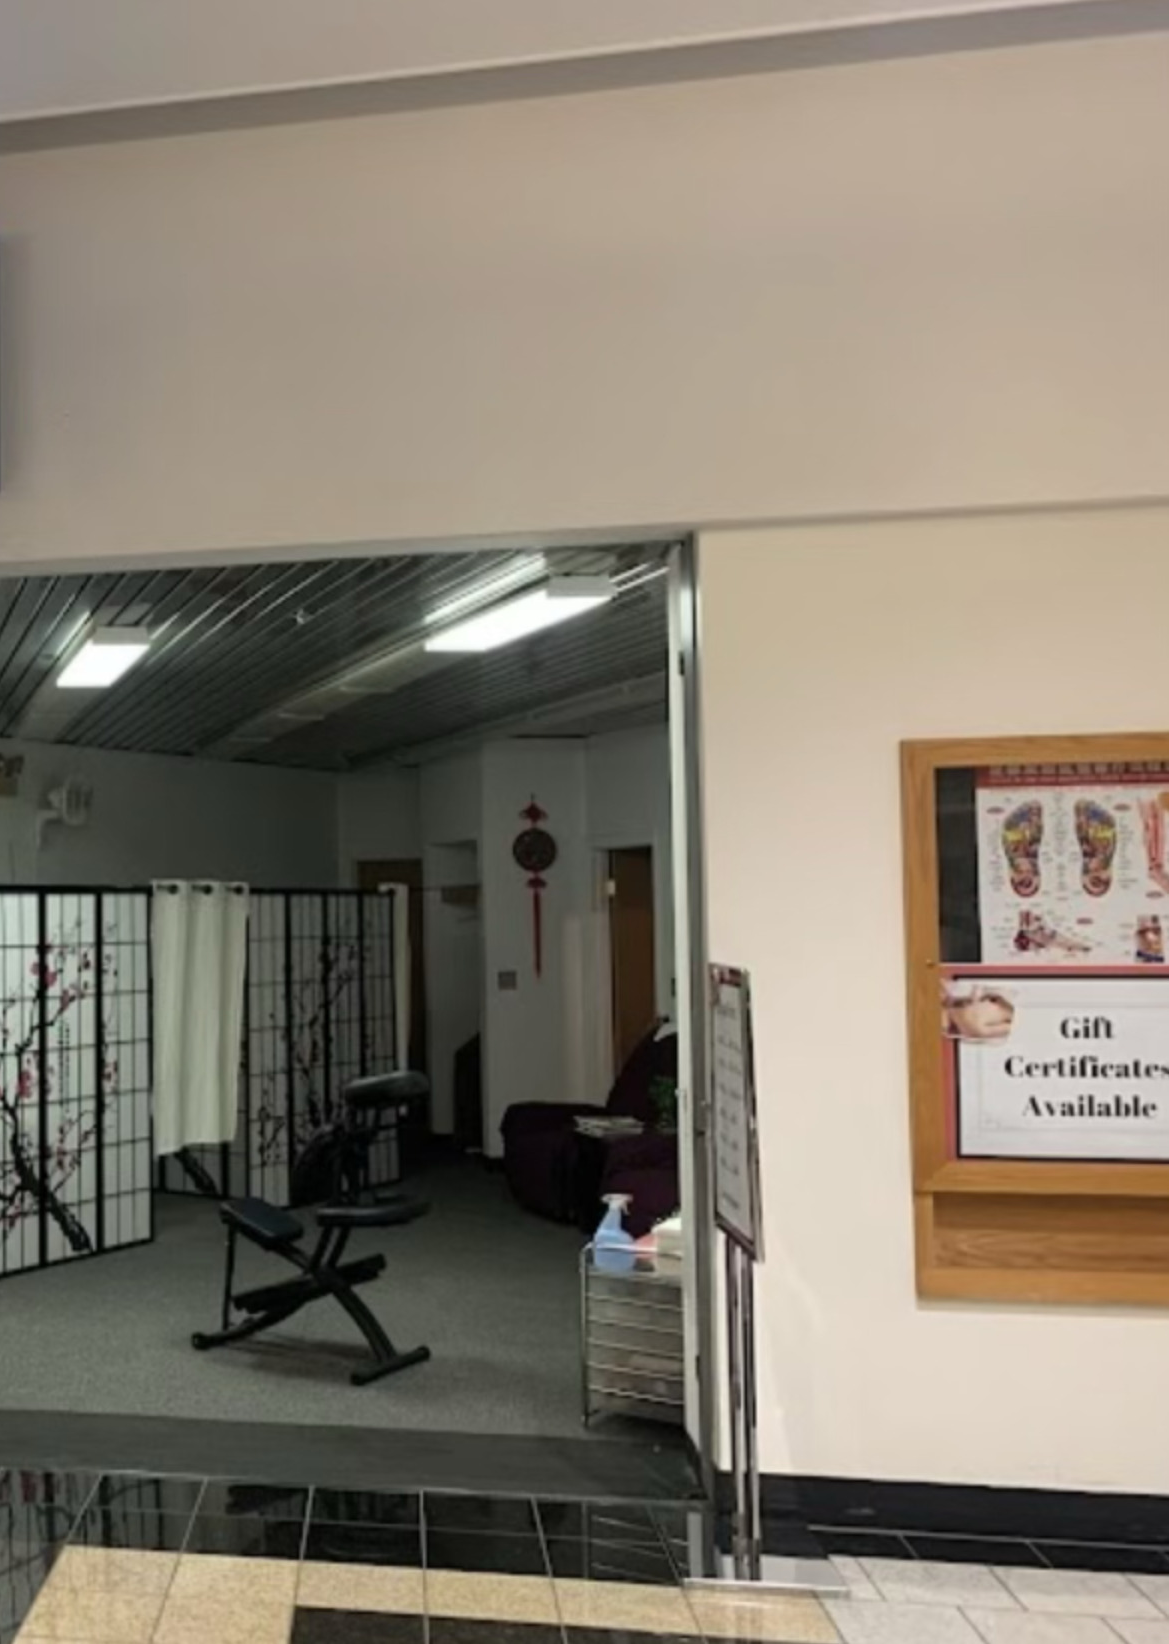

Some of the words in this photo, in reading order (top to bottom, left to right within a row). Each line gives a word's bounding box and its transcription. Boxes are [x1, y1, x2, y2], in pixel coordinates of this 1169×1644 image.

[1059, 1015, 1114, 1040] Gift
[1003, 1054, 1169, 1079] Certificates
[1022, 1094, 1158, 1118] Available
